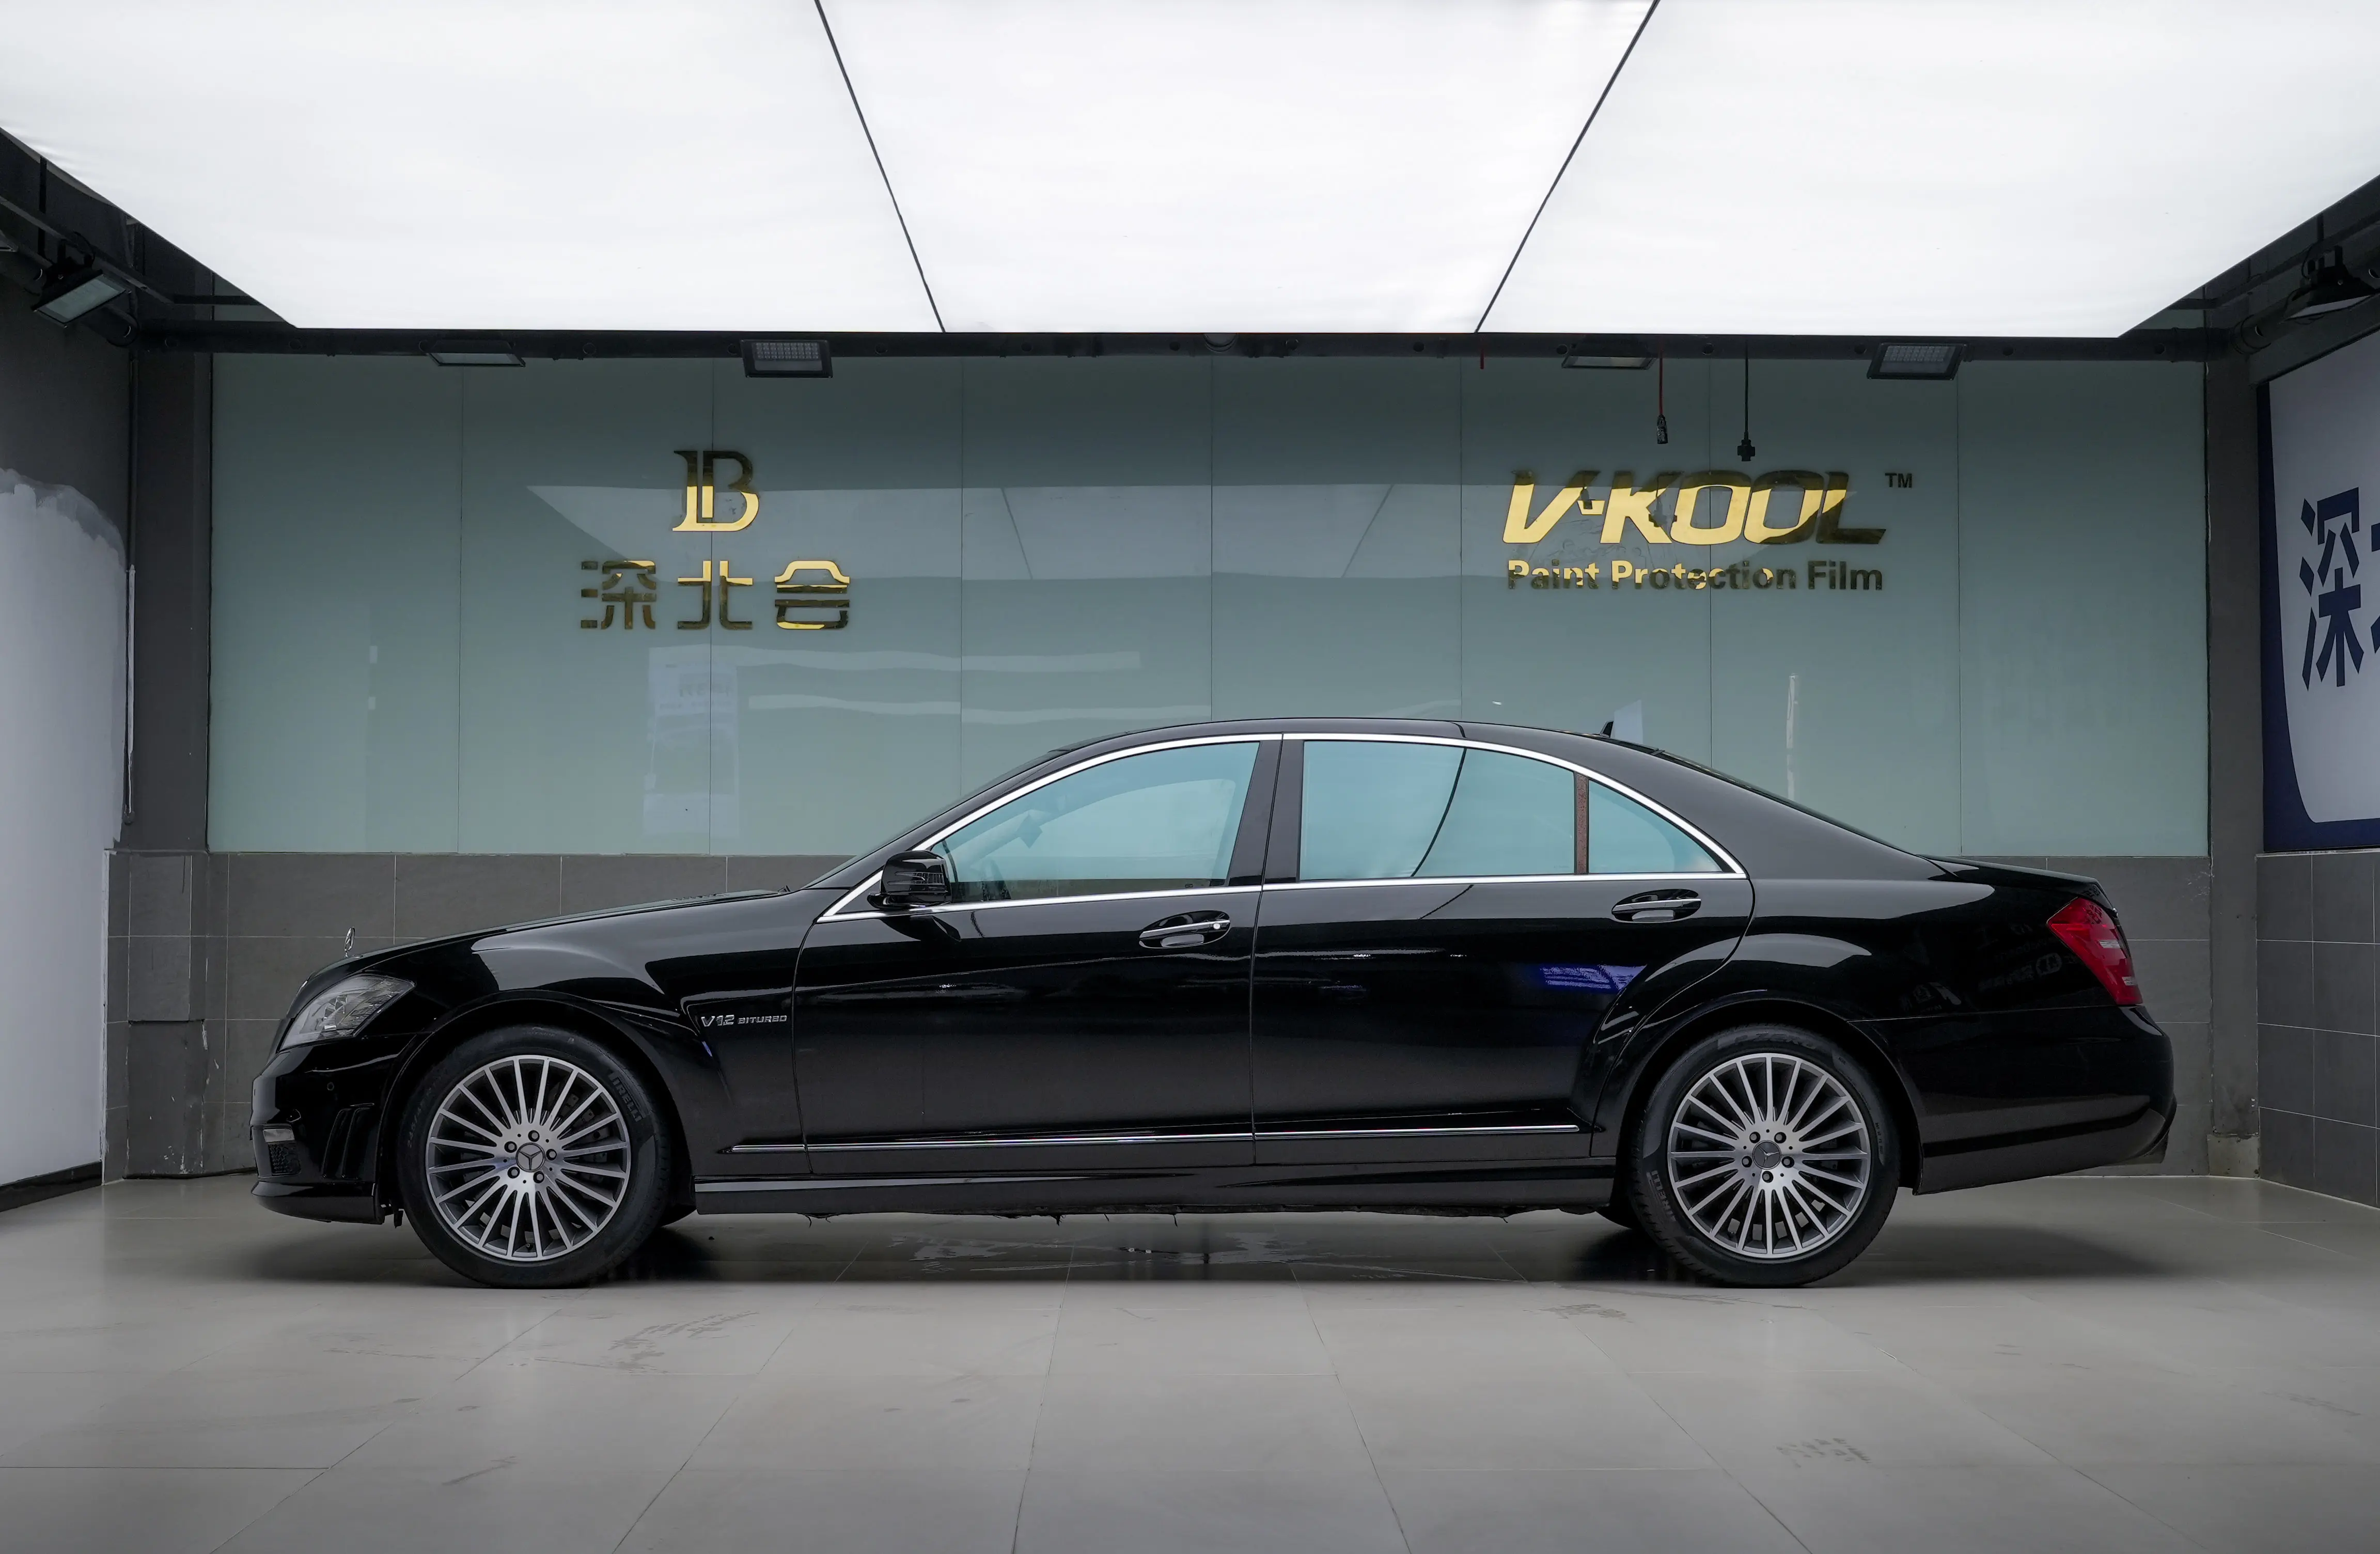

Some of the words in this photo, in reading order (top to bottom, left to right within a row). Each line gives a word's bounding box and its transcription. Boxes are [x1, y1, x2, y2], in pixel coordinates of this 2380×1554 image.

[1507, 559, 1600, 590] Paint
[1611, 559, 1796, 590] Protection
[1808, 560, 1883, 590] Film
[701, 1014, 734, 1027] V12
[737, 1015, 787, 1025] BITURBO
